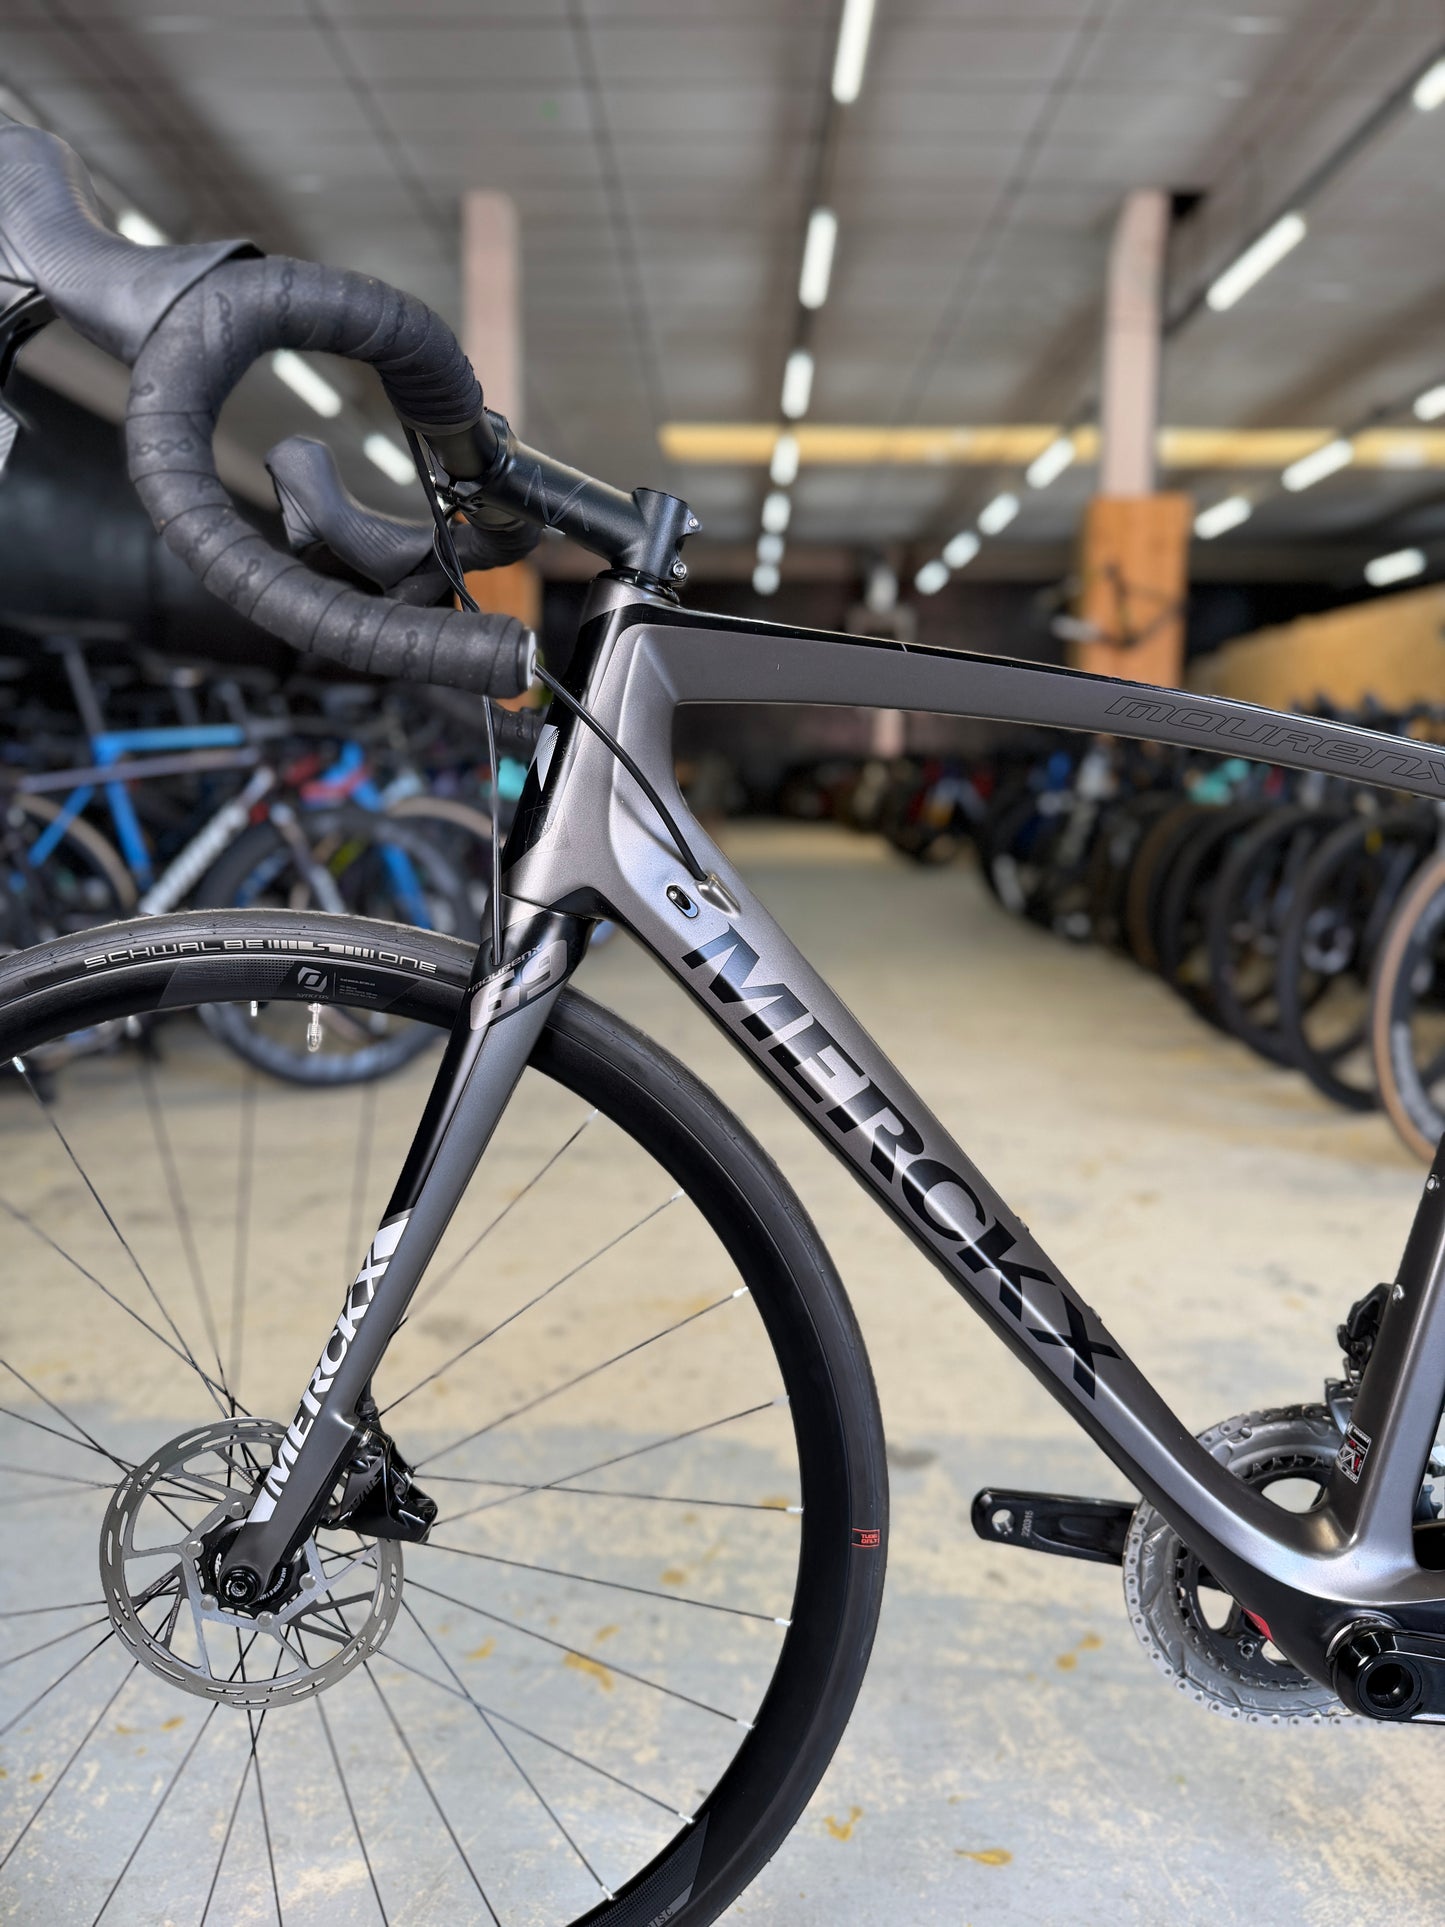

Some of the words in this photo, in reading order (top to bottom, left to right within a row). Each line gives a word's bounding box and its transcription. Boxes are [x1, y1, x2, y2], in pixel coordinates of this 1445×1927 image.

[84, 939, 264, 969] SCHWALBE
[681, 924, 1122, 1399] MERCKX
[266, 1250, 389, 1498] MERCKX
[647, 1905, 674, 1927] ISC
